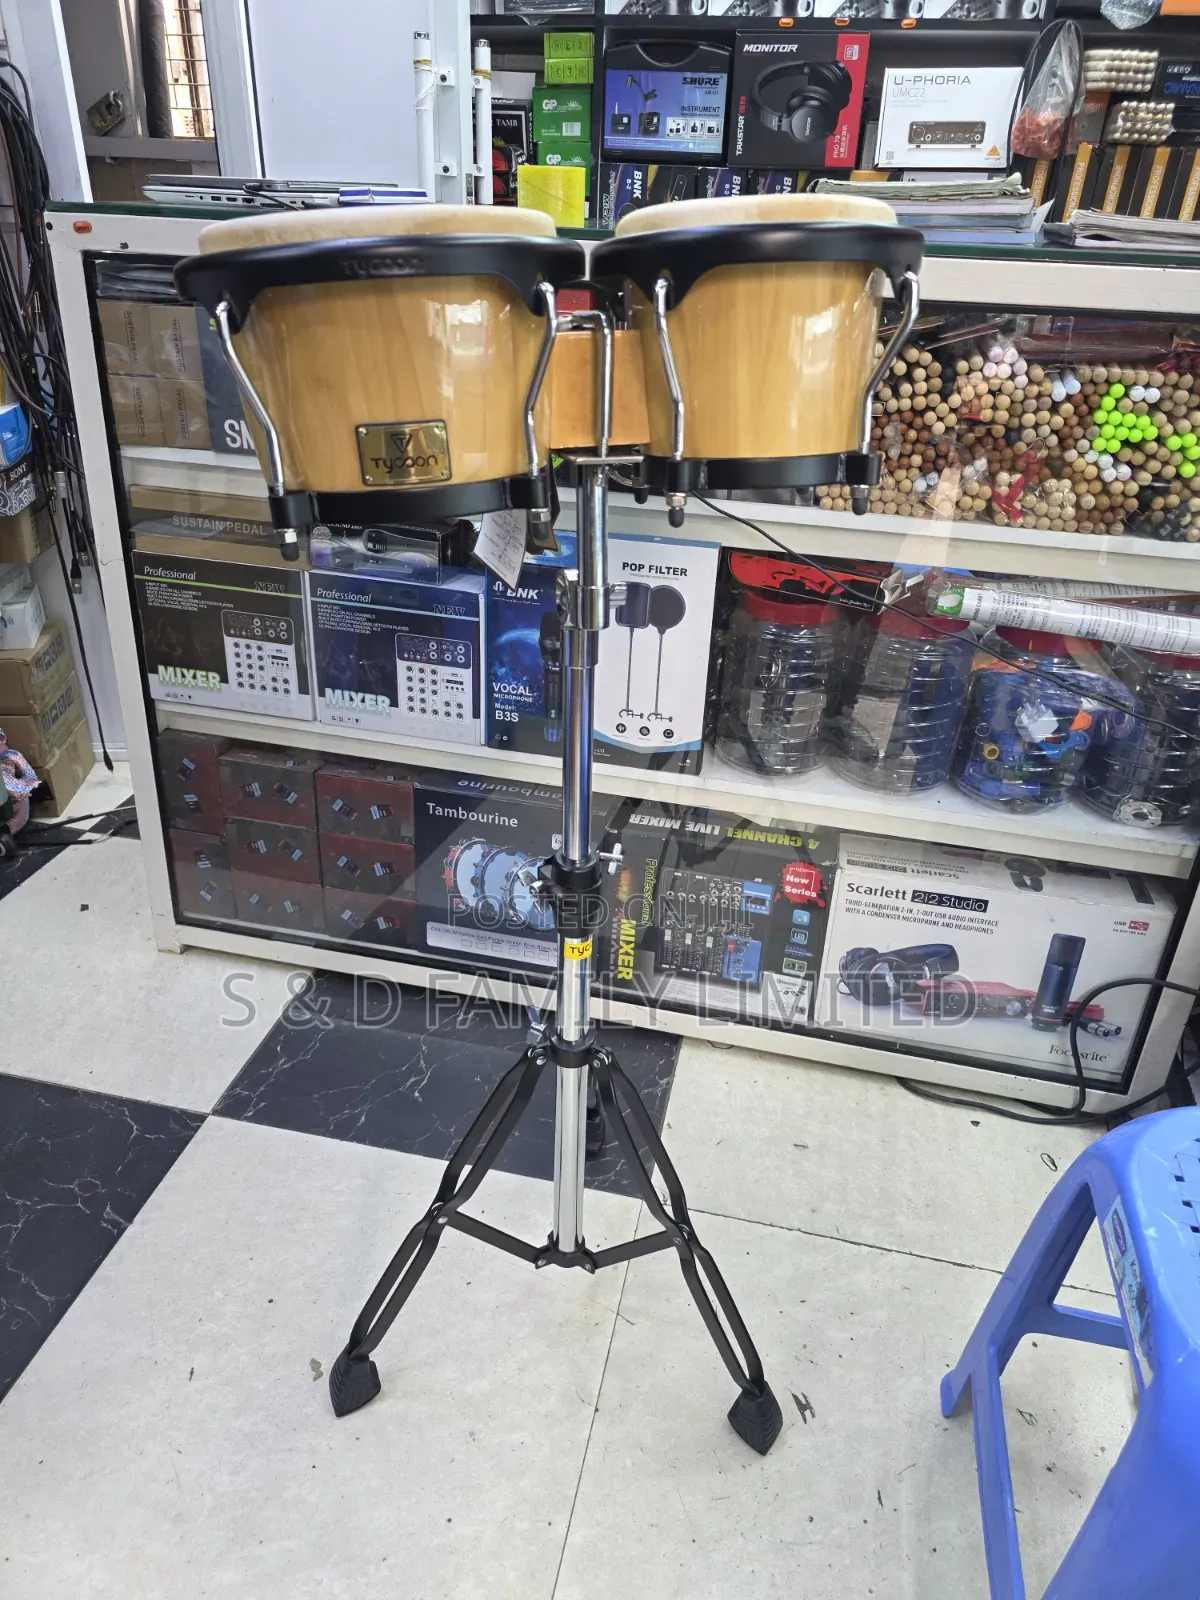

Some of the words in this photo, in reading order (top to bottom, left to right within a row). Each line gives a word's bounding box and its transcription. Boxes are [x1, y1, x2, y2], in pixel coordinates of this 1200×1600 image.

[742, 44, 799, 53] MONITOR
[681, 76, 721, 87] SHURE
[893, 75, 971, 86] U-PHORIA
[892, 87, 926, 98] UMC22
[542, 99, 558, 110] GP
[680, 105, 721, 113] INSTRUMENT
[496, 118, 518, 128] TAMB
[735, 115, 745, 156] TAKSTAR
[546, 154, 562, 165] GP
[633, 170, 642, 200] BNK
[1106, 164, 1122, 213] MICROPHONE
[9, 462, 27, 481] SONY
[172, 515, 223, 531] SUSTAIN
[226, 521, 267, 535] PEDAL
[144, 565, 196, 580] Professional
[622, 562, 645, 572] POP
[648, 564, 688, 577] FILTER
[254, 581, 285, 594] NEW
[317, 588, 371, 603] Professional
[433, 604, 465, 616] NEW
[157, 664, 223, 690] MIXER
[493, 682, 533, 696] VOCAL
[324, 687, 391, 712] MIXER
[493, 693, 533, 703] MICROPHONE
[494, 703, 517, 711] Model:
[495, 710, 519, 722] B3S
[426, 802, 519, 828] Tambourine
[629, 813, 682, 830] MIXER
[684, 820, 721, 836] LIVE
[725, 826, 803, 848] CHANNEL
[807, 838, 820, 850] 4
[786, 874, 809, 885] New
[910, 868, 960, 879] Scarlett
[641, 858, 658, 927] Professional
[784, 885, 817, 898] Series
[846, 882, 907, 900] Scarlett
[914, 892, 940, 904] 2i2
[941, 896, 985, 912] Studio
[845, 898, 900, 912] THIRD-GENERATION
[916, 909, 934, 918] 2-OUT
[934, 912, 947, 920] USB
[948, 914, 967, 922] AUDIO
[967, 916, 999, 927] INTERFACE
[845, 906, 861, 915] WITH
[866, 909, 901, 921] CONDENSER
[902, 916, 940, 927] MICROPHONE
[941, 921, 954, 929] AND
[954, 923, 994, 935] HEADPHONES
[794, 932, 805, 941] LED
[617, 917, 637, 981] MIXER
[1048, 1044, 1107, 1062] Focsrite
